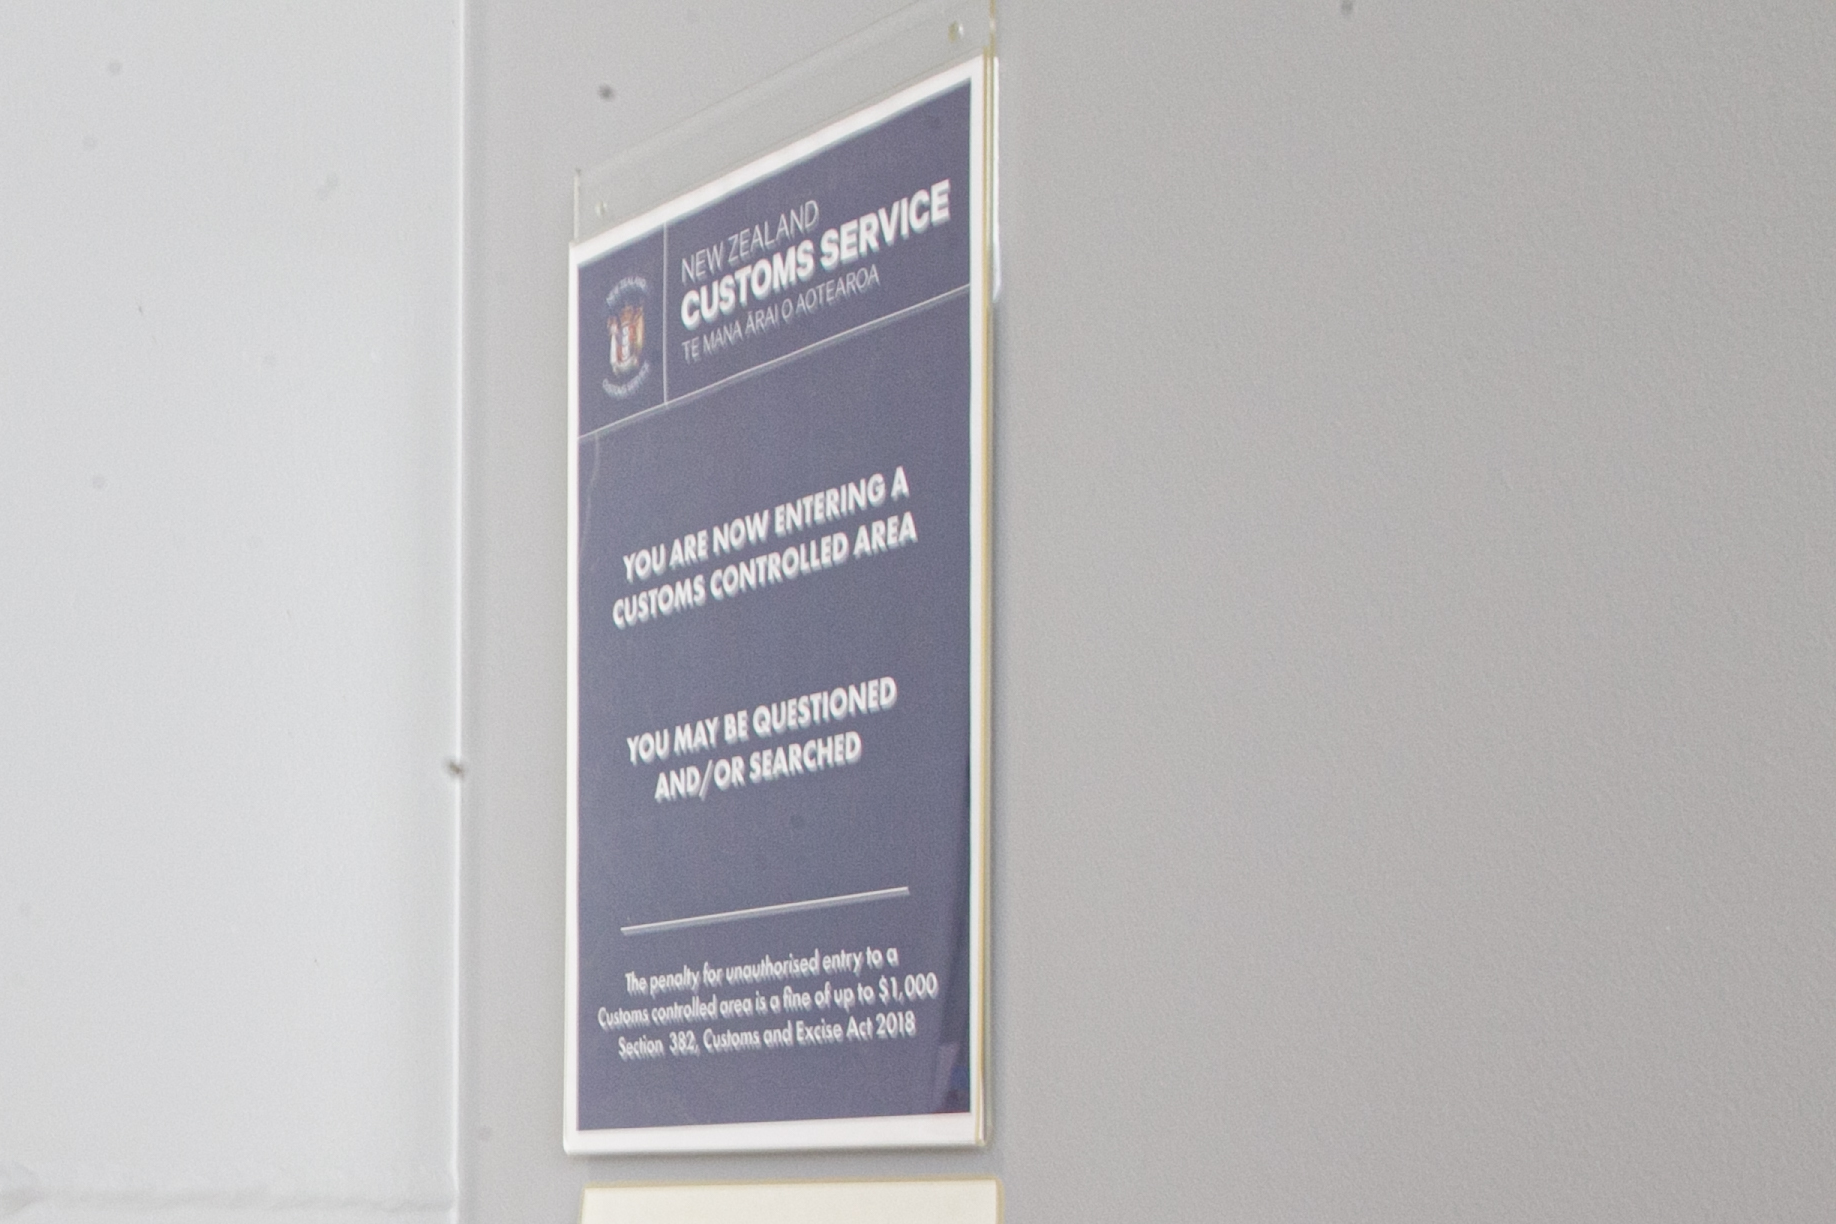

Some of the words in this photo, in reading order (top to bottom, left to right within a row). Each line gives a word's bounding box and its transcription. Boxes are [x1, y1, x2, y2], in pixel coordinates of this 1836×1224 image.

[681, 239, 814, 329] CUSTOMS
[820, 179, 951, 270] SERVICE
[682, 241, 724, 283] NEW
[728, 200, 819, 263] ZEALAND
[682, 337, 700, 362] TE
[703, 320, 742, 354] MANA
[782, 298, 794, 322] O
[795, 264, 880, 315] AOTEAROA
[623, 544, 665, 582] YOU
[670, 530, 709, 569] ARE
[713, 511, 769, 553] NOW
[774, 474, 885, 533] ENTERING
[891, 466, 910, 498] A
[612, 576, 705, 629] CUSTOMS
[710, 532, 849, 600] CONTROLLED
[853, 512, 918, 557] AREA
[627, 730, 668, 765] YOU
[673, 717, 719, 755] MAY
[724, 711, 749, 742] BE
[752, 676, 897, 735] QUESTIONED
[654, 756, 745, 803] AND/OR
[749, 731, 862, 783] SEARCHED
[597, 1006, 649, 1031] Customs
[651, 995, 718, 1027] controlled
[720, 998, 753, 1018] area
[755, 992, 766, 1014] is
[769, 996, 780, 1013] a
[783, 986, 811, 1011] fine
[814, 982, 832, 1007] of
[833, 988, 855, 1013] up
[857, 983, 874, 1003] to
[878, 972, 939, 1004] $1,000
[625, 972, 647, 997] The
[649, 963, 700, 1000] penalty
[703, 961, 723, 986] for
[725, 949, 820, 983] unauthorised
[822, 948, 862, 975] entry
[866, 948, 883, 968] to
[886, 948, 899, 966] a
[618, 1029, 663, 1061] Section
[668, 1028, 700, 1057] 382,
[703, 1026, 760, 1053] Customs
[763, 1020, 793, 1047] and
[796, 1019, 843, 1044] Excise
[846, 1018, 873, 1039] Act
[875, 1010, 916, 1037] 2018
